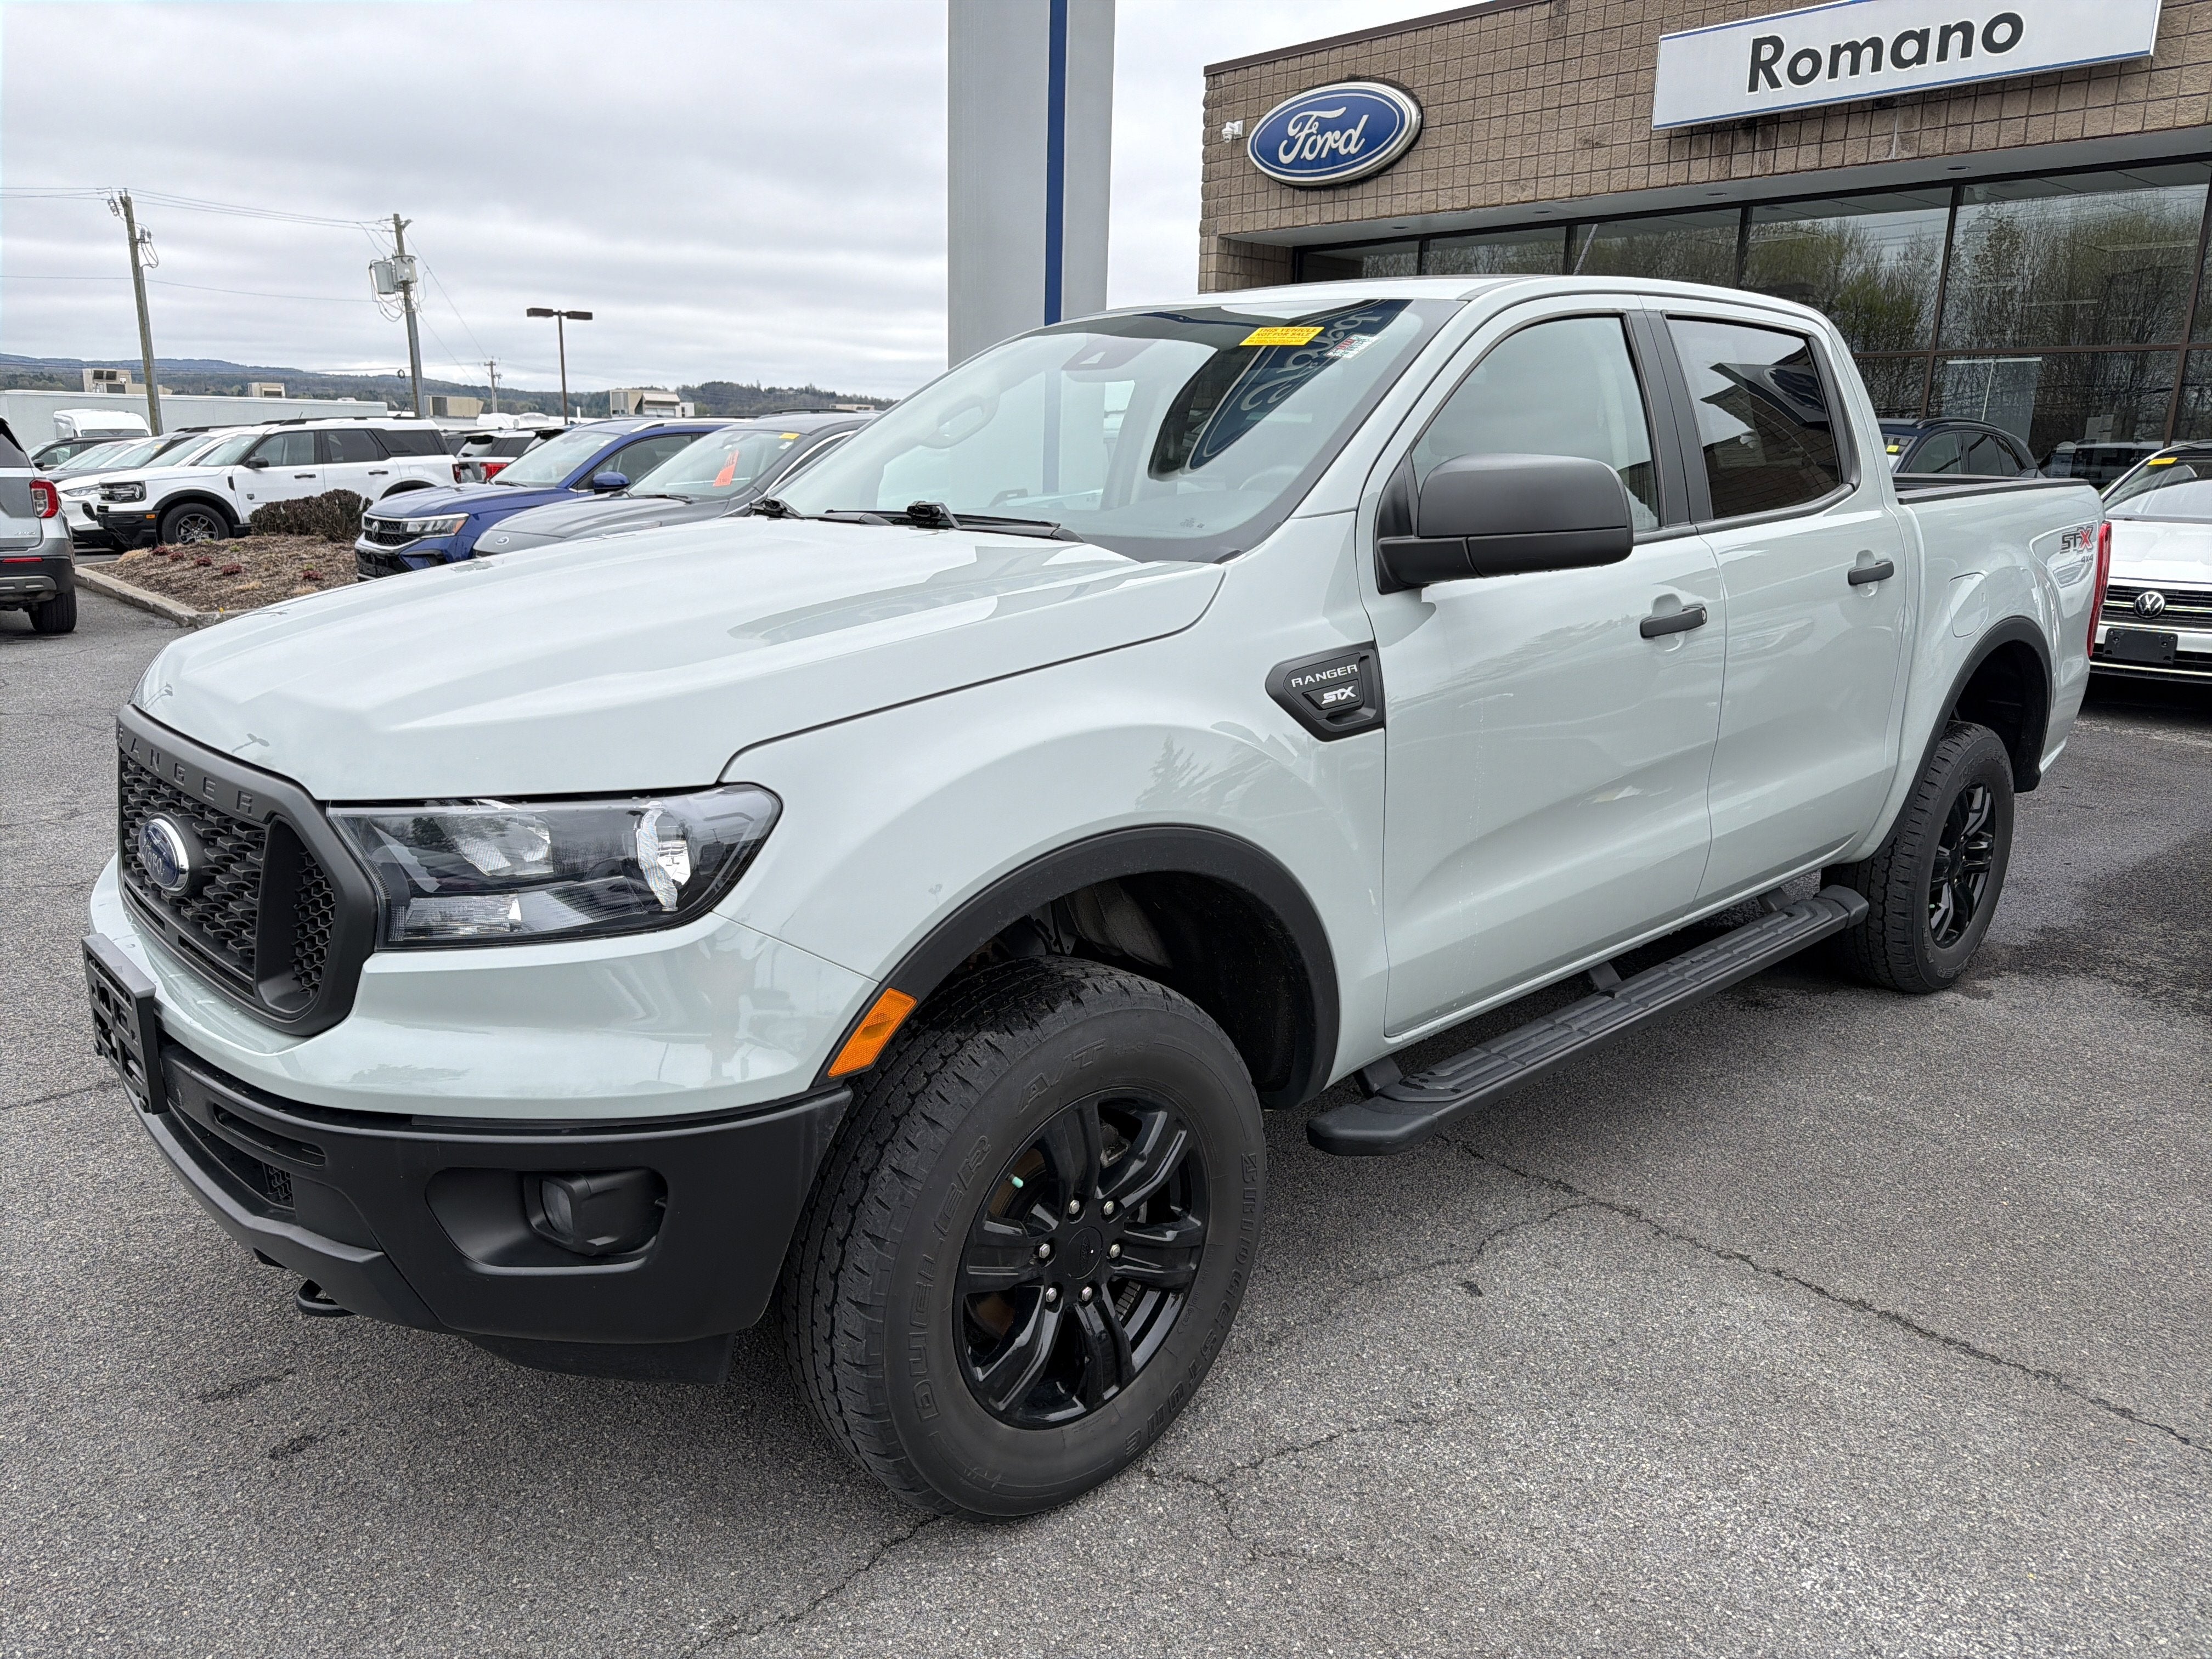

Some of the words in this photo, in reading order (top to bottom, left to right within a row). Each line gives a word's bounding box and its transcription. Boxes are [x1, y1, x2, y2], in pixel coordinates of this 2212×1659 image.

[1747, 12, 2024, 94] Romano
[1278, 106, 1369, 164] Ford
[2060, 526, 2094, 553] STX
[1291, 664, 1358, 687] RANGER
[1322, 685, 1357, 704] STX
[117, 724, 252, 816] RANGER
[909, 1135, 992, 1423] DUELER
